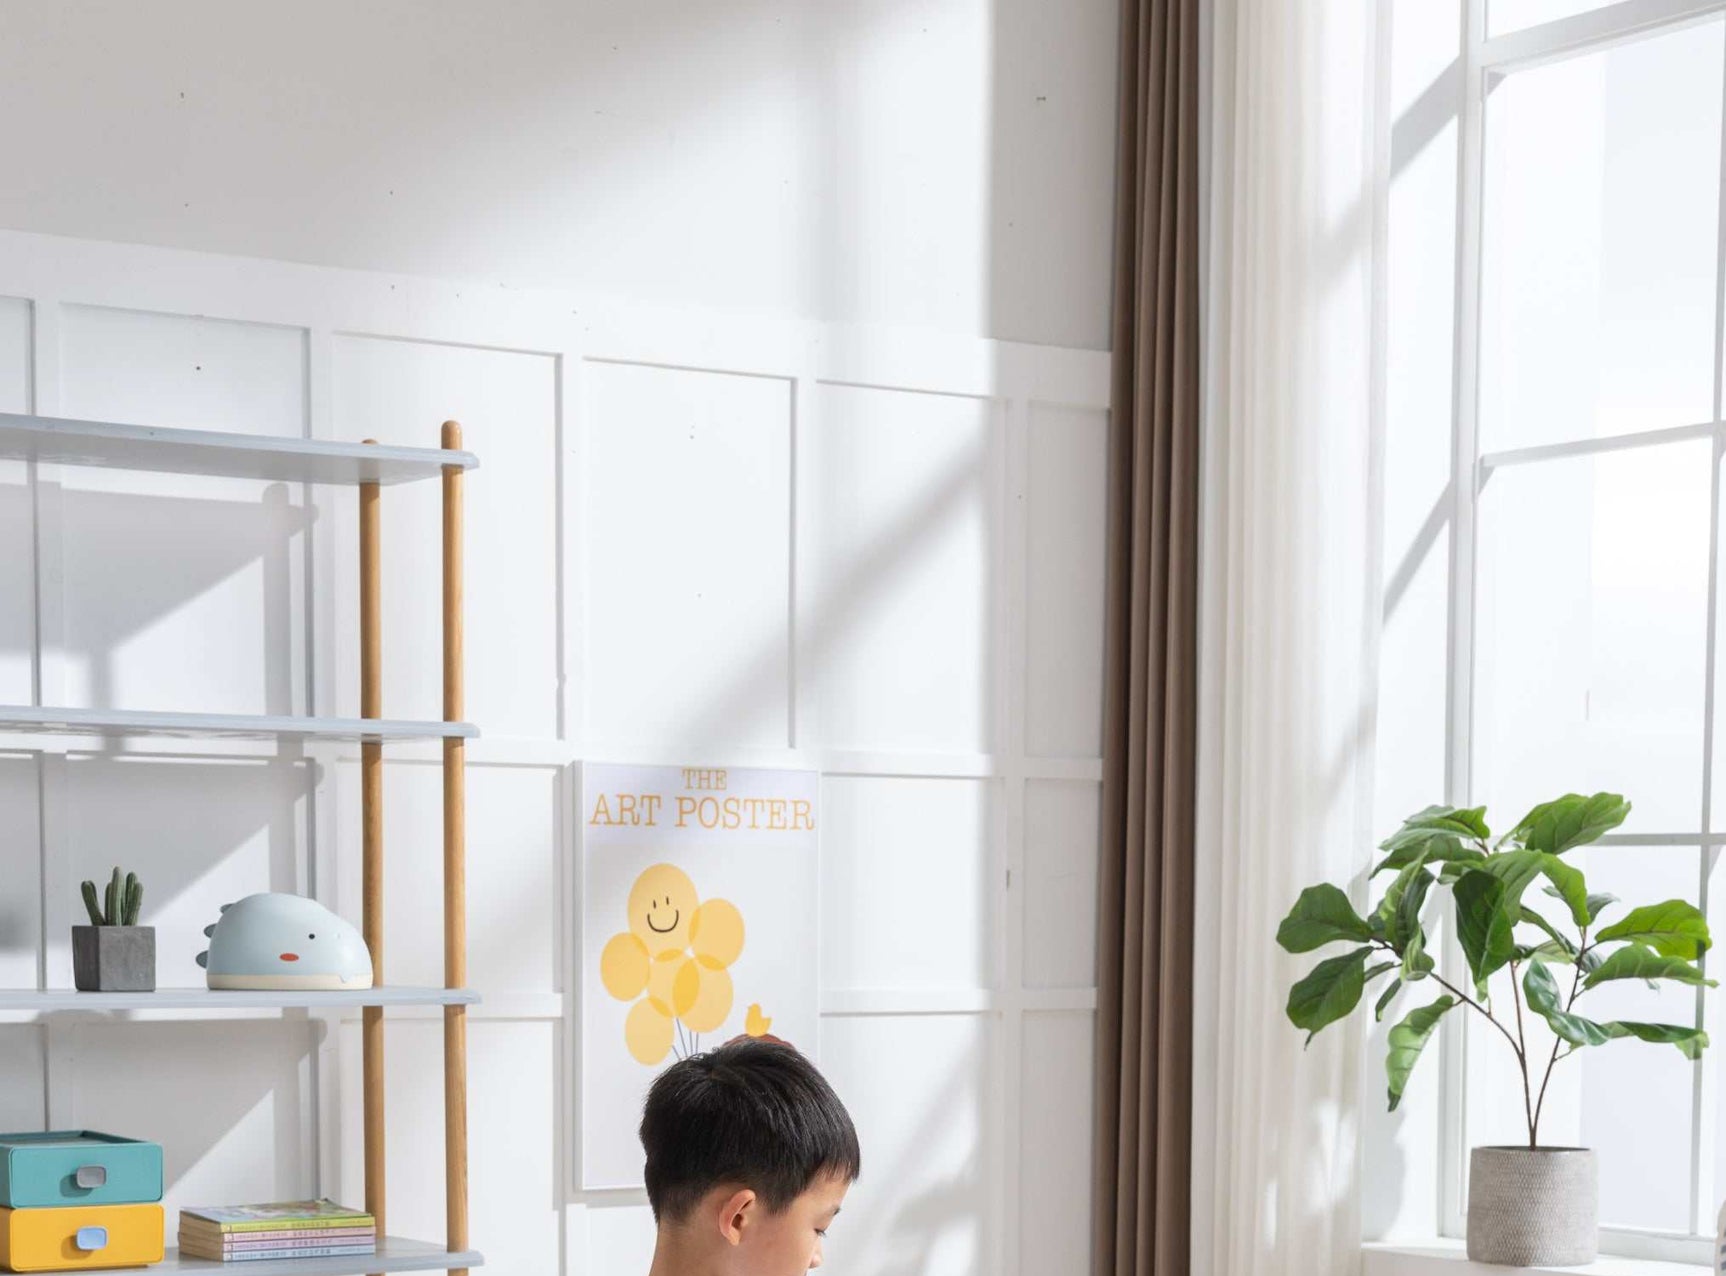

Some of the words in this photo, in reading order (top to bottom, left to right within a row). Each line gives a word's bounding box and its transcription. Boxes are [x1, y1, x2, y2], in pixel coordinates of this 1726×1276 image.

[682, 768, 727, 790] THE
[590, 794, 661, 826] ART
[675, 797, 814, 830] POSTER
